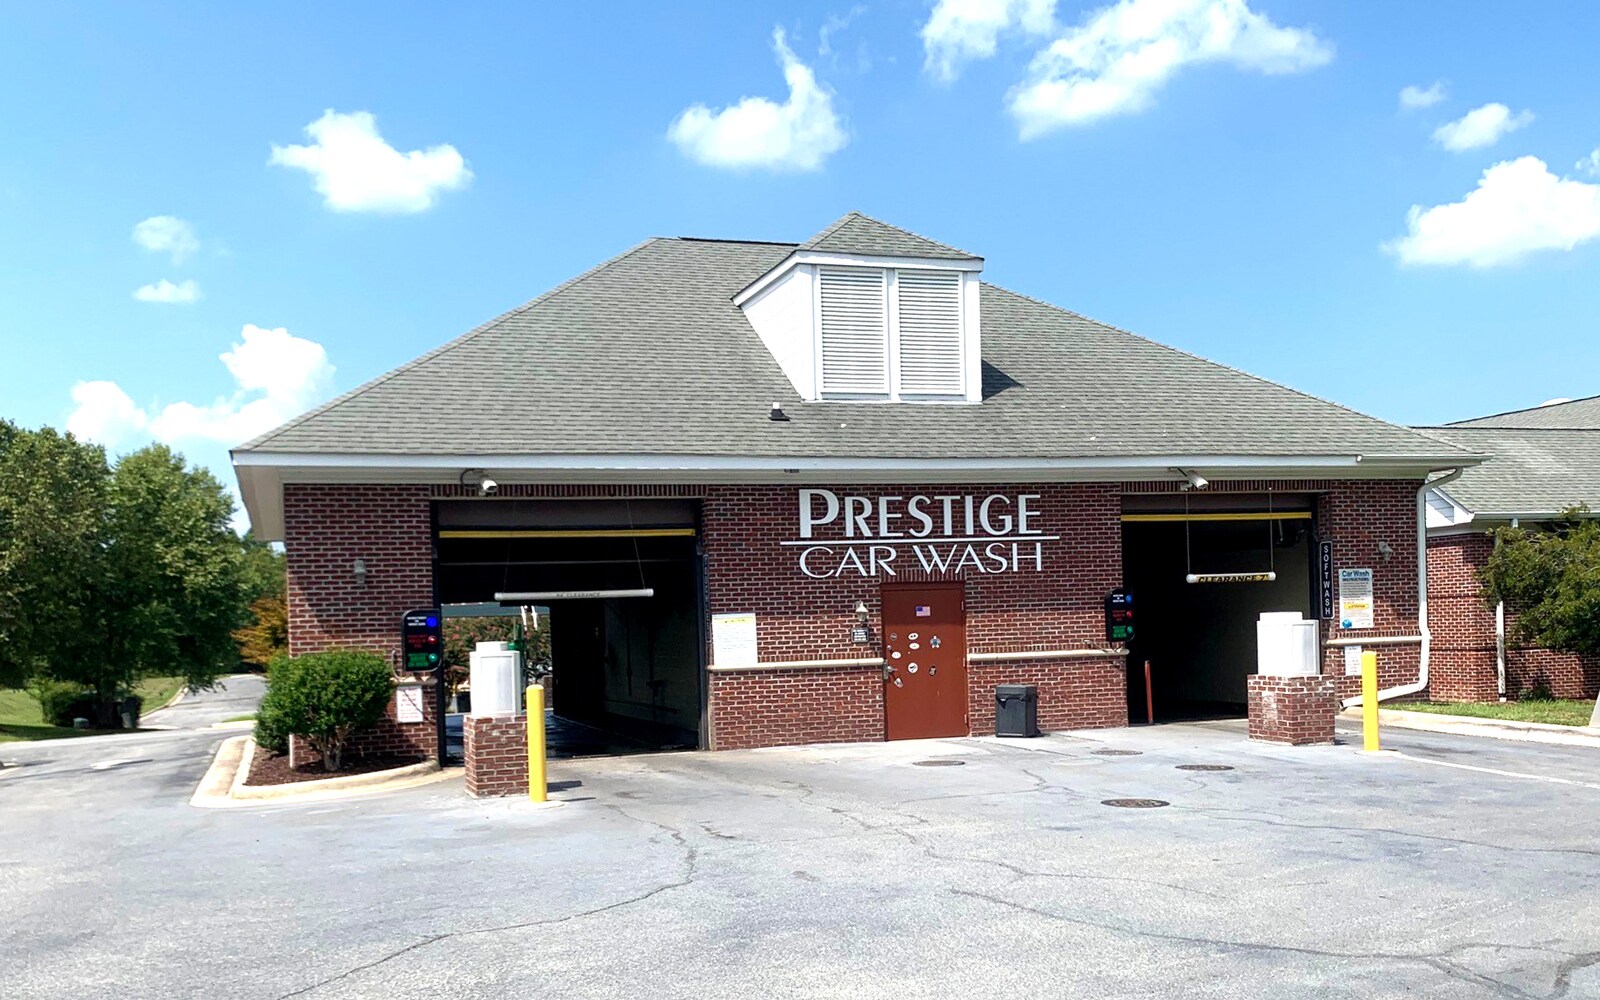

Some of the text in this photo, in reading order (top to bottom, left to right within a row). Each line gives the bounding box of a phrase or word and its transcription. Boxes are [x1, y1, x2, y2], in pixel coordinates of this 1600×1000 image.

[799, 489, 1042, 537] PRESTIGE
[799, 542, 1042, 578] CAR WASH
[1198, 575, 1257, 583] CLEARANCE
[1323, 545, 1331, 615] SOFTWASH
